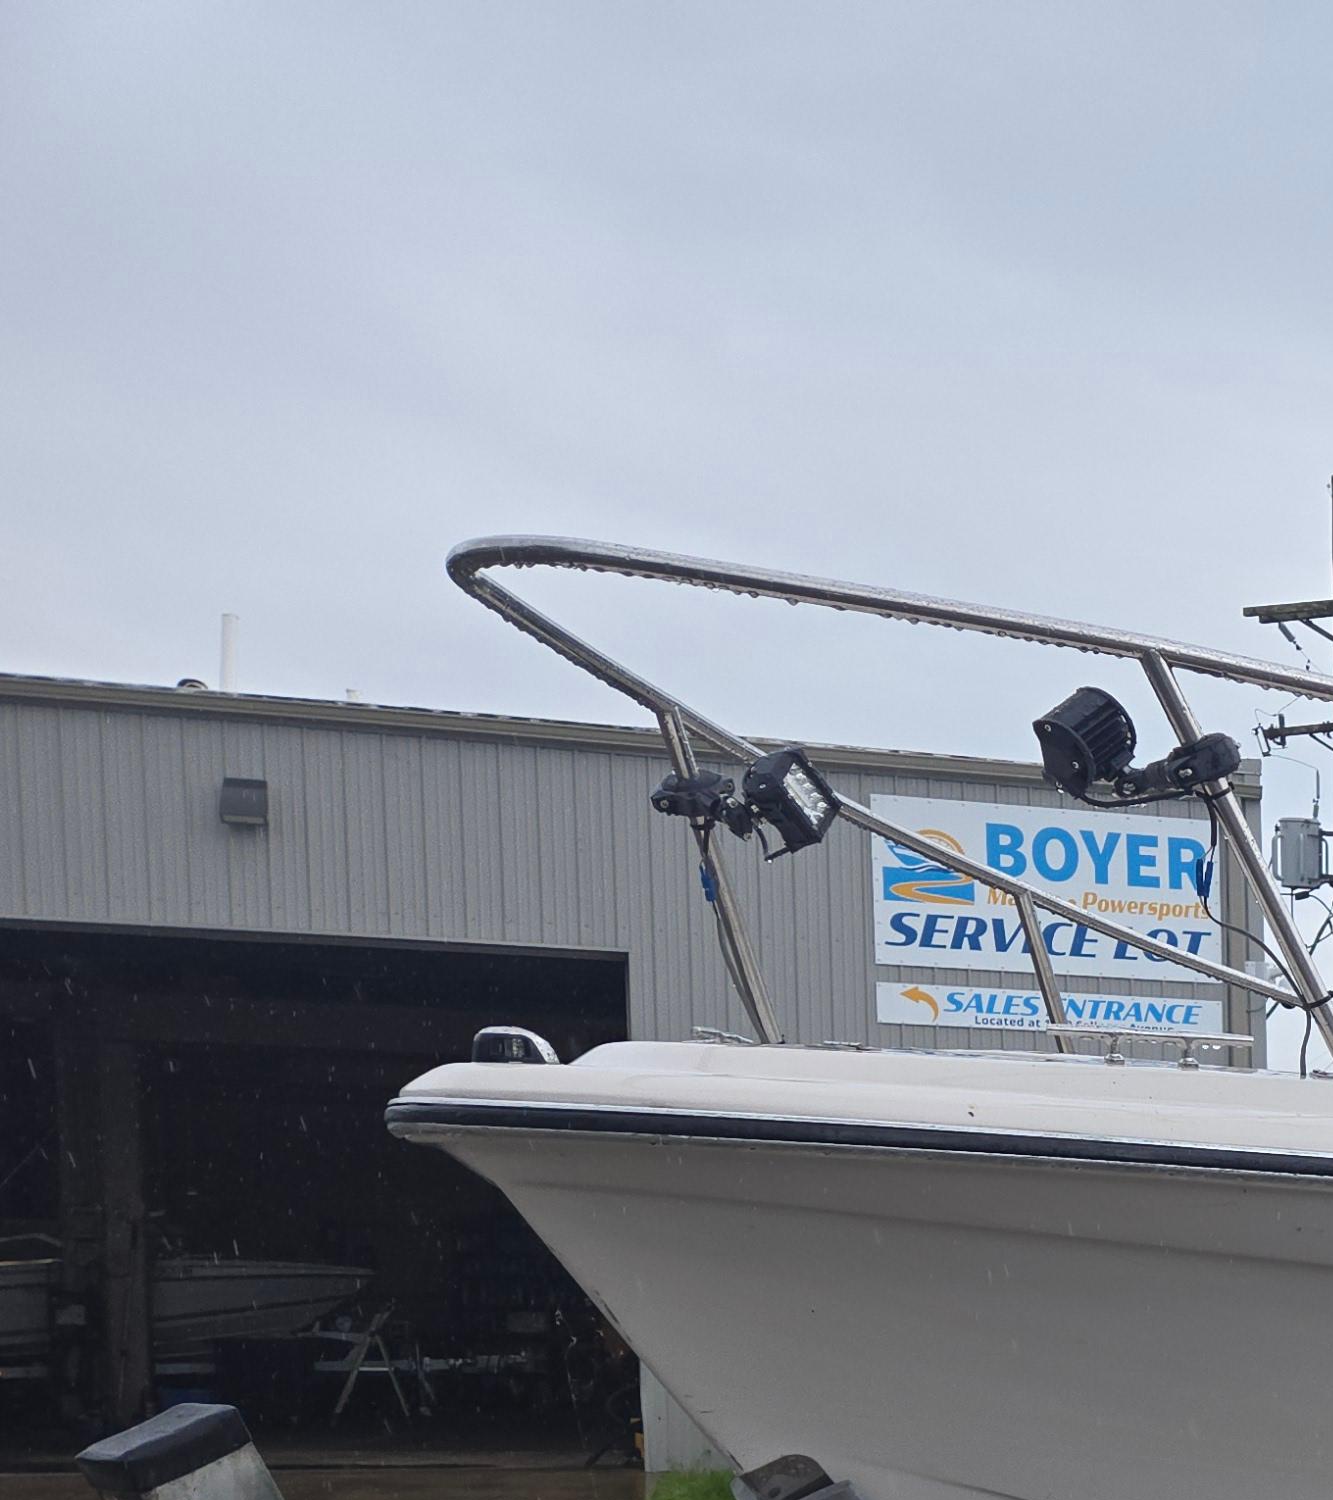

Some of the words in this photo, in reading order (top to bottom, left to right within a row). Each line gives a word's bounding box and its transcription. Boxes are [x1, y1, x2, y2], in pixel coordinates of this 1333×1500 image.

[985, 822, 1208, 892] BOYER
[1082, 891, 1209, 921] Powersports
[944, 991, 1041, 1017] SALES
[1047, 997, 1203, 1026] NTRANCE
[974, 1015, 1024, 1027] Located
[1028, 1018, 1041, 1028] at
